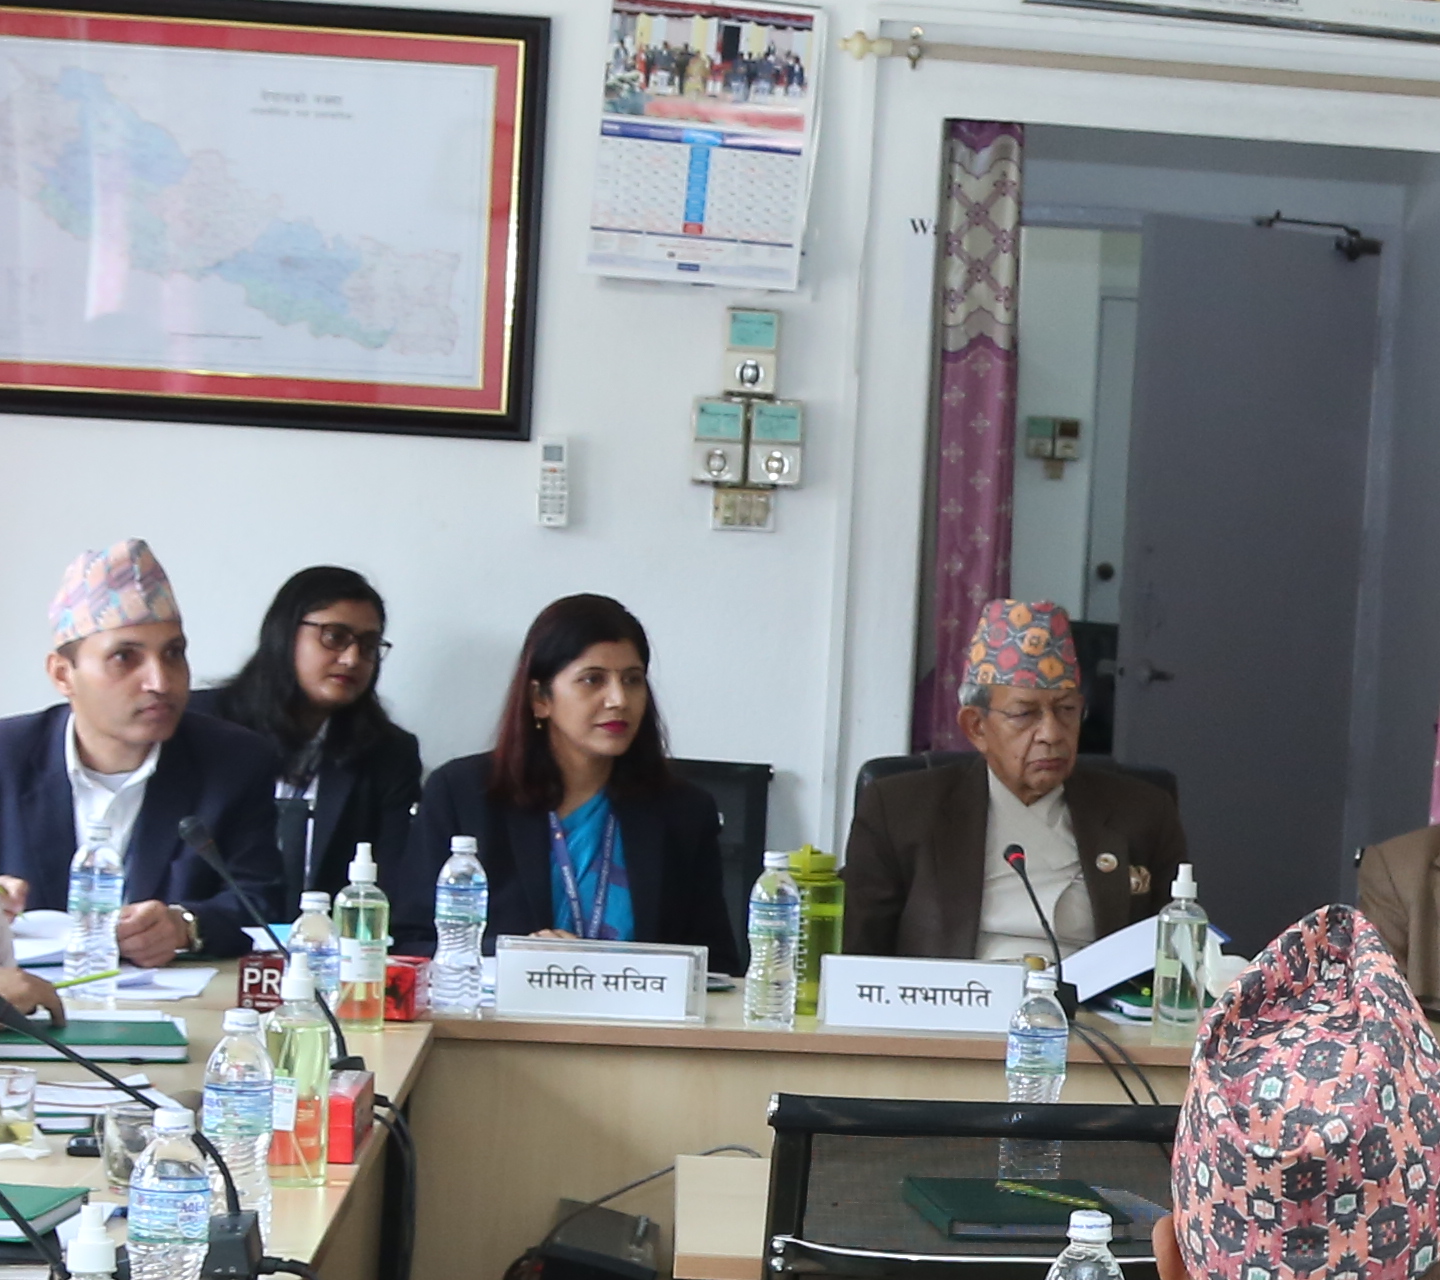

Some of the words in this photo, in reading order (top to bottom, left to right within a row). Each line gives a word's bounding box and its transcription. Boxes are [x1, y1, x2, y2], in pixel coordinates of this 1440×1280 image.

[525, 963, 596, 991] समिति
[601, 966, 668, 993] सचिव
[855, 983, 891, 1005] मा.
[897, 979, 993, 1008] सभापति
